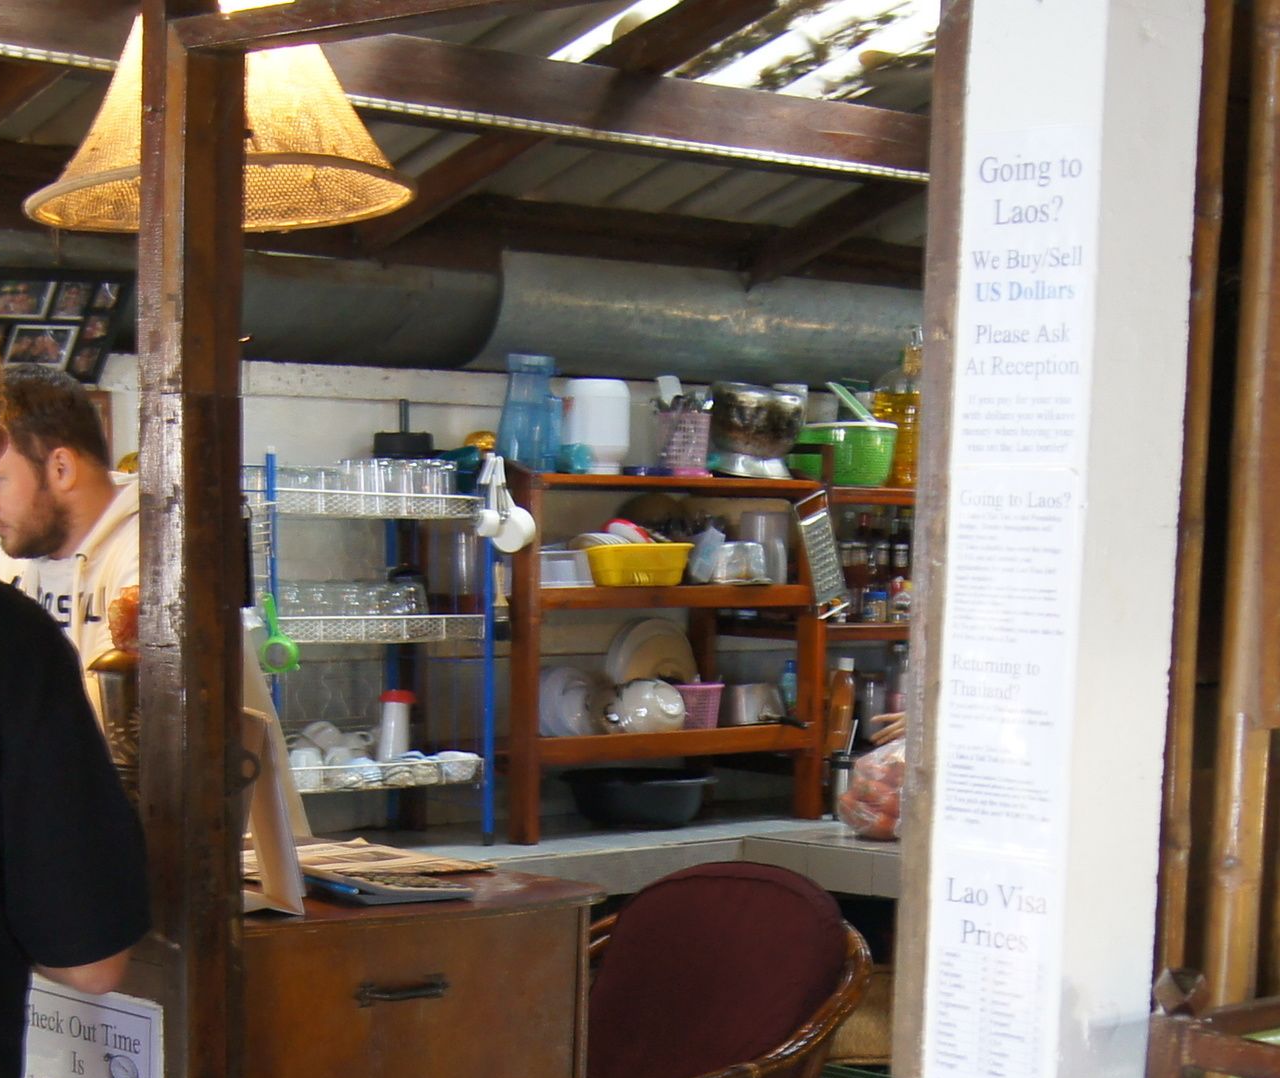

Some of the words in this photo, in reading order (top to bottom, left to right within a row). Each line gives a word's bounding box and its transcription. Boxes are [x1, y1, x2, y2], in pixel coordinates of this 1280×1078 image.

[978, 155, 1052, 187] Going
[1060, 156, 1082, 178] to
[994, 195, 1064, 225] Laos?
[972, 250, 1000, 270] We
[1007, 246, 1082, 274] Buy/Sell
[975, 282, 1001, 302] US
[1008, 281, 1075, 301] Dollars
[975, 324, 1029, 344] Please
[1035, 323, 1071, 343] Ask
[965, 358, 985, 376] At
[992, 357, 1080, 379] Reception
[960, 491, 1004, 510] Going
[1009, 491, 1022, 507] to
[1027, 491, 1072, 508] Laos?
[952, 654, 1021, 679] Returning
[1026, 661, 1040, 676] to
[950, 679, 1020, 701] Thailand?
[946, 877, 988, 906] Lao
[997, 884, 1047, 915] Visa
[960, 919, 1029, 952] Prices
[69, 1015, 96, 1043] Out
[101, 1023, 141, 1055] Time
[72, 1051, 84, 1075] Is
